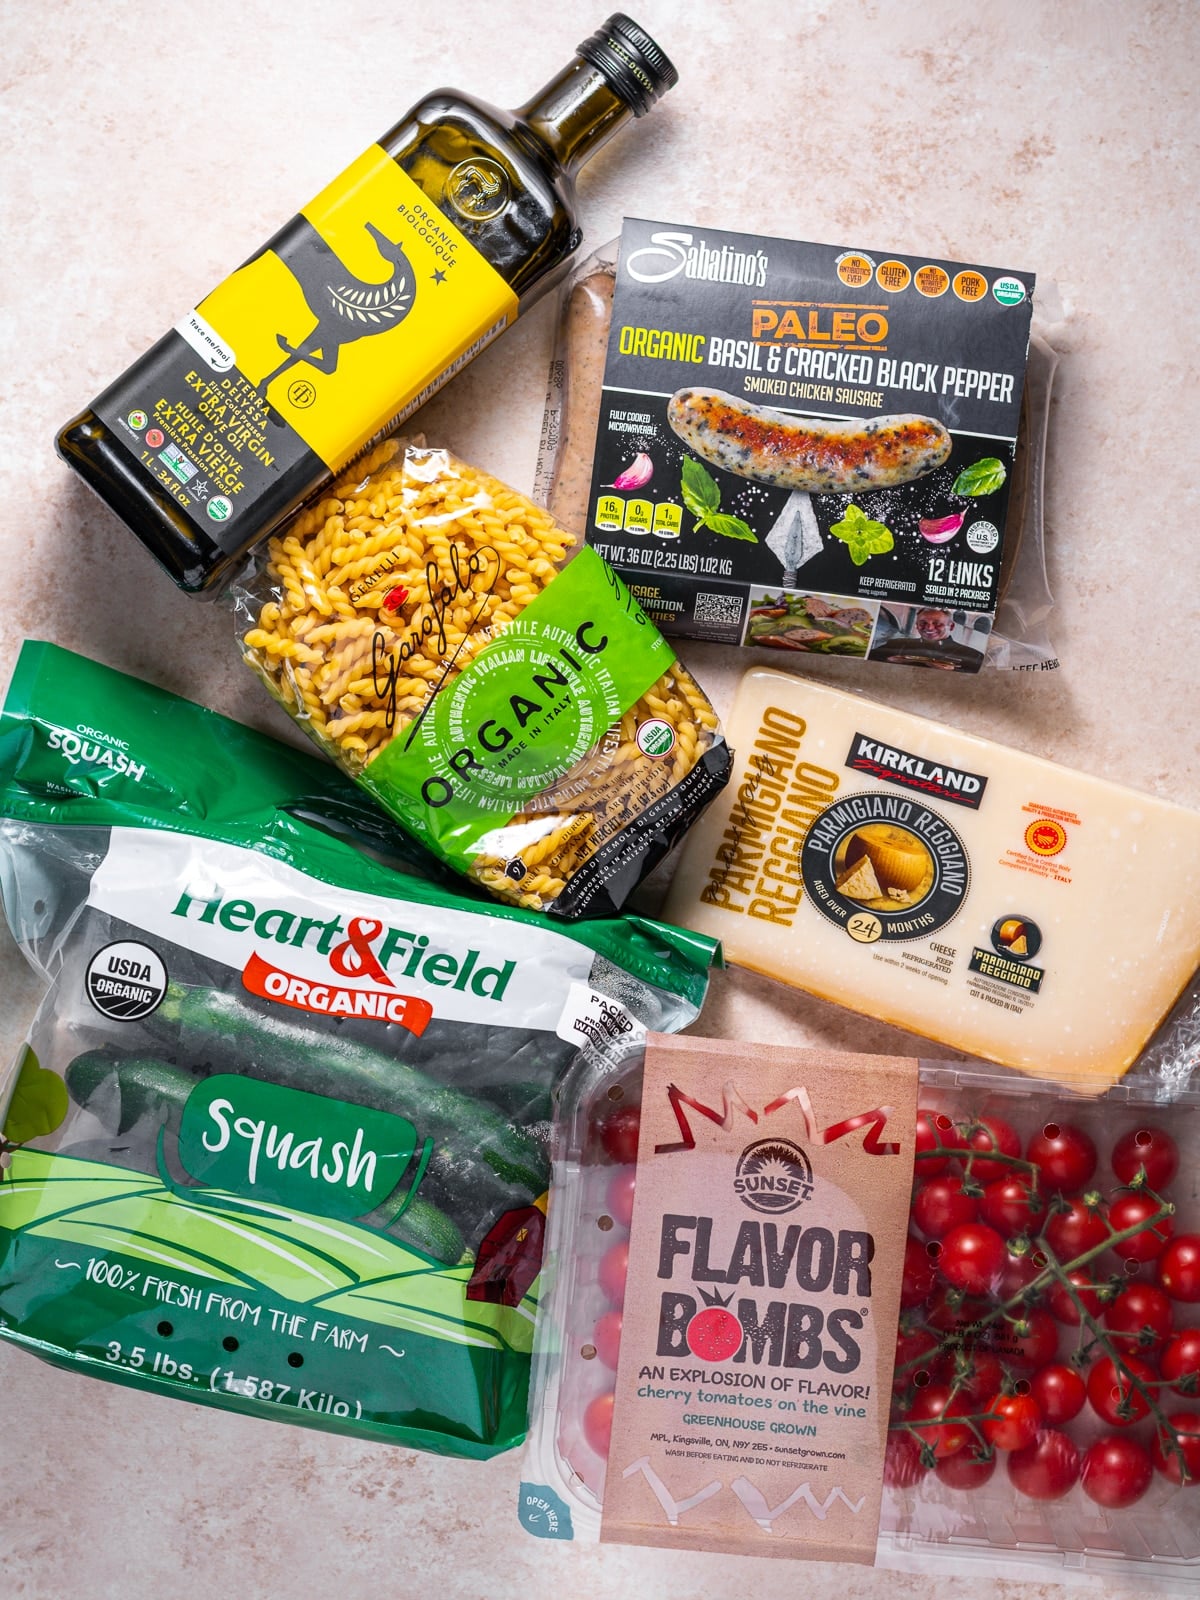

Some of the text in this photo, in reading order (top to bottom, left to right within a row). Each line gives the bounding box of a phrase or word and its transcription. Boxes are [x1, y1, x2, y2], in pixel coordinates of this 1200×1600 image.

[397, 204, 457, 268] BIOLOGIQUE
[413, 205, 458, 253] ORGANIC
[627, 232, 768, 287] Sabatino's
[839, 266, 870, 276] ANTIBIOTICS
[851, 259, 861, 267] NO
[881, 266, 907, 278] GLUTEN
[847, 275, 862, 284] EVER
[884, 276, 901, 287] FREE
[961, 276, 980, 287] PORK
[961, 286, 978, 297] FREE
[1000, 282, 1019, 290] USDA
[190, 318, 230, 362] Trace me/moi
[752, 309, 889, 343] PALEO
[619, 326, 1015, 403] ORGANIC BASIL & CRACKED BLACK PEPPER
[221, 378, 268, 430] DELYSSA
[236, 377, 270, 416] TERRA
[744, 376, 884, 408] SMOKED CHICKEN SAUSAGE
[184, 371, 226, 417] EXTRA
[229, 415, 276, 467] VIRGIN
[198, 402, 245, 452] OLIVE OIL
[209, 380, 266, 442] First Cold Pressed
[609, 410, 650, 423] FULLY COOKED
[153, 411, 182, 443] Première
[182, 442, 209, 473] Pression
[213, 476, 231, 496] froid
[155, 398, 199, 446] EXTRA
[199, 445, 245, 495] VIERGE
[175, 402, 205, 433] HUILE
[203, 431, 244, 473] D'OLIVE
[157, 470, 192, 508] 34 fl oz
[600, 512, 620, 521] PROTEIN
[629, 516, 648, 525] SUGARS
[968, 521, 997, 538] INSPECTED
[593, 543, 733, 576] NET WT. 36 OZ (2.25 LBS) 1.02 KG
[927, 558, 994, 588] 12 LINKS
[351, 551, 400, 603] GEMELLI
[859, 576, 916, 592] KEEP REFRIGERATED
[925, 584, 946, 596] SEALED
[947, 586, 954, 596] IN
[954, 588, 960, 596] 2
[960, 589, 990, 601] PACKAGES
[372, 544, 501, 729] Garofalo
[595, 668, 622, 716] ITALIAN
[421, 621, 608, 808] ORGANIC
[449, 649, 594, 788] AUTHENTIC ITALIAN AUTHENTIC ITALIAN
[497, 694, 572, 769] MADE IN ITALY
[76, 724, 130, 751] ORGANIC
[643, 726, 662, 744] USDA
[47, 730, 146, 782] SQUASH
[857, 739, 981, 794] KIRKLAND
[589, 783, 610, 801] FROM
[853, 758, 976, 804] Signature
[478, 795, 526, 814] ITALIAN
[561, 764, 649, 842] DURUM SEMOLINA
[700, 706, 807, 914] PARMIGIANO
[551, 827, 590, 866] ORGANIC
[567, 766, 701, 894] PASTA DI SEMOLA DI GRANO DURO
[574, 815, 621, 862] NET WEIGHT
[747, 761, 841, 927] REGGIANO
[808, 797, 913, 854] PARMIGIANO
[913, 811, 966, 896] REGGIANO
[578, 828, 654, 900] IMPORTED IN THE USA
[622, 838, 654, 866] ARIZONA
[1054, 874, 1072, 884] ITALY
[813, 880, 848, 918] AGED OVER
[850, 920, 878, 939] 24
[887, 912, 935, 934] MONTHS
[902, 952, 952, 974] REFRIGERATED
[929, 942, 957, 958] CHEESE
[935, 955, 954, 967] KEEP
[975, 951, 1042, 981] PARMIGIANO
[107, 955, 152, 982] USDA
[979, 962, 1032, 988] REGGIANO
[95, 976, 153, 1005] ORGANIC
[263, 971, 408, 1024] ORGANIC
[590, 995, 634, 1032] PACKED
[202, 1098, 377, 1192] Squash
[733, 1175, 814, 1199] SUNSET
[657, 1213, 875, 1297] FLAVOR
[85, 1257, 370, 1353] 100% FRESH FROM THE FARM
[656, 1288, 864, 1374] BOMBS
[106, 1340, 364, 1421] 3.5 lbs. (1.587 Kilo)
[638, 1366, 871, 1400] AN EXPLOSION OF FLAVOR!
[637, 1384, 867, 1418] cherry tomatoes on the vine
[683, 1414, 817, 1437] GREENHOUSE GROWN
[650, 1433, 846, 1460] MPL, Kingsville, ON, N9Y 2E5 sunsetgrown.com
[664, 1449, 828, 1472] WASH BEFORE EATING AND DO NOT REFRIGERATE
[526, 1496, 550, 1512] OPEN
[546, 1510, 559, 1533] HERE
